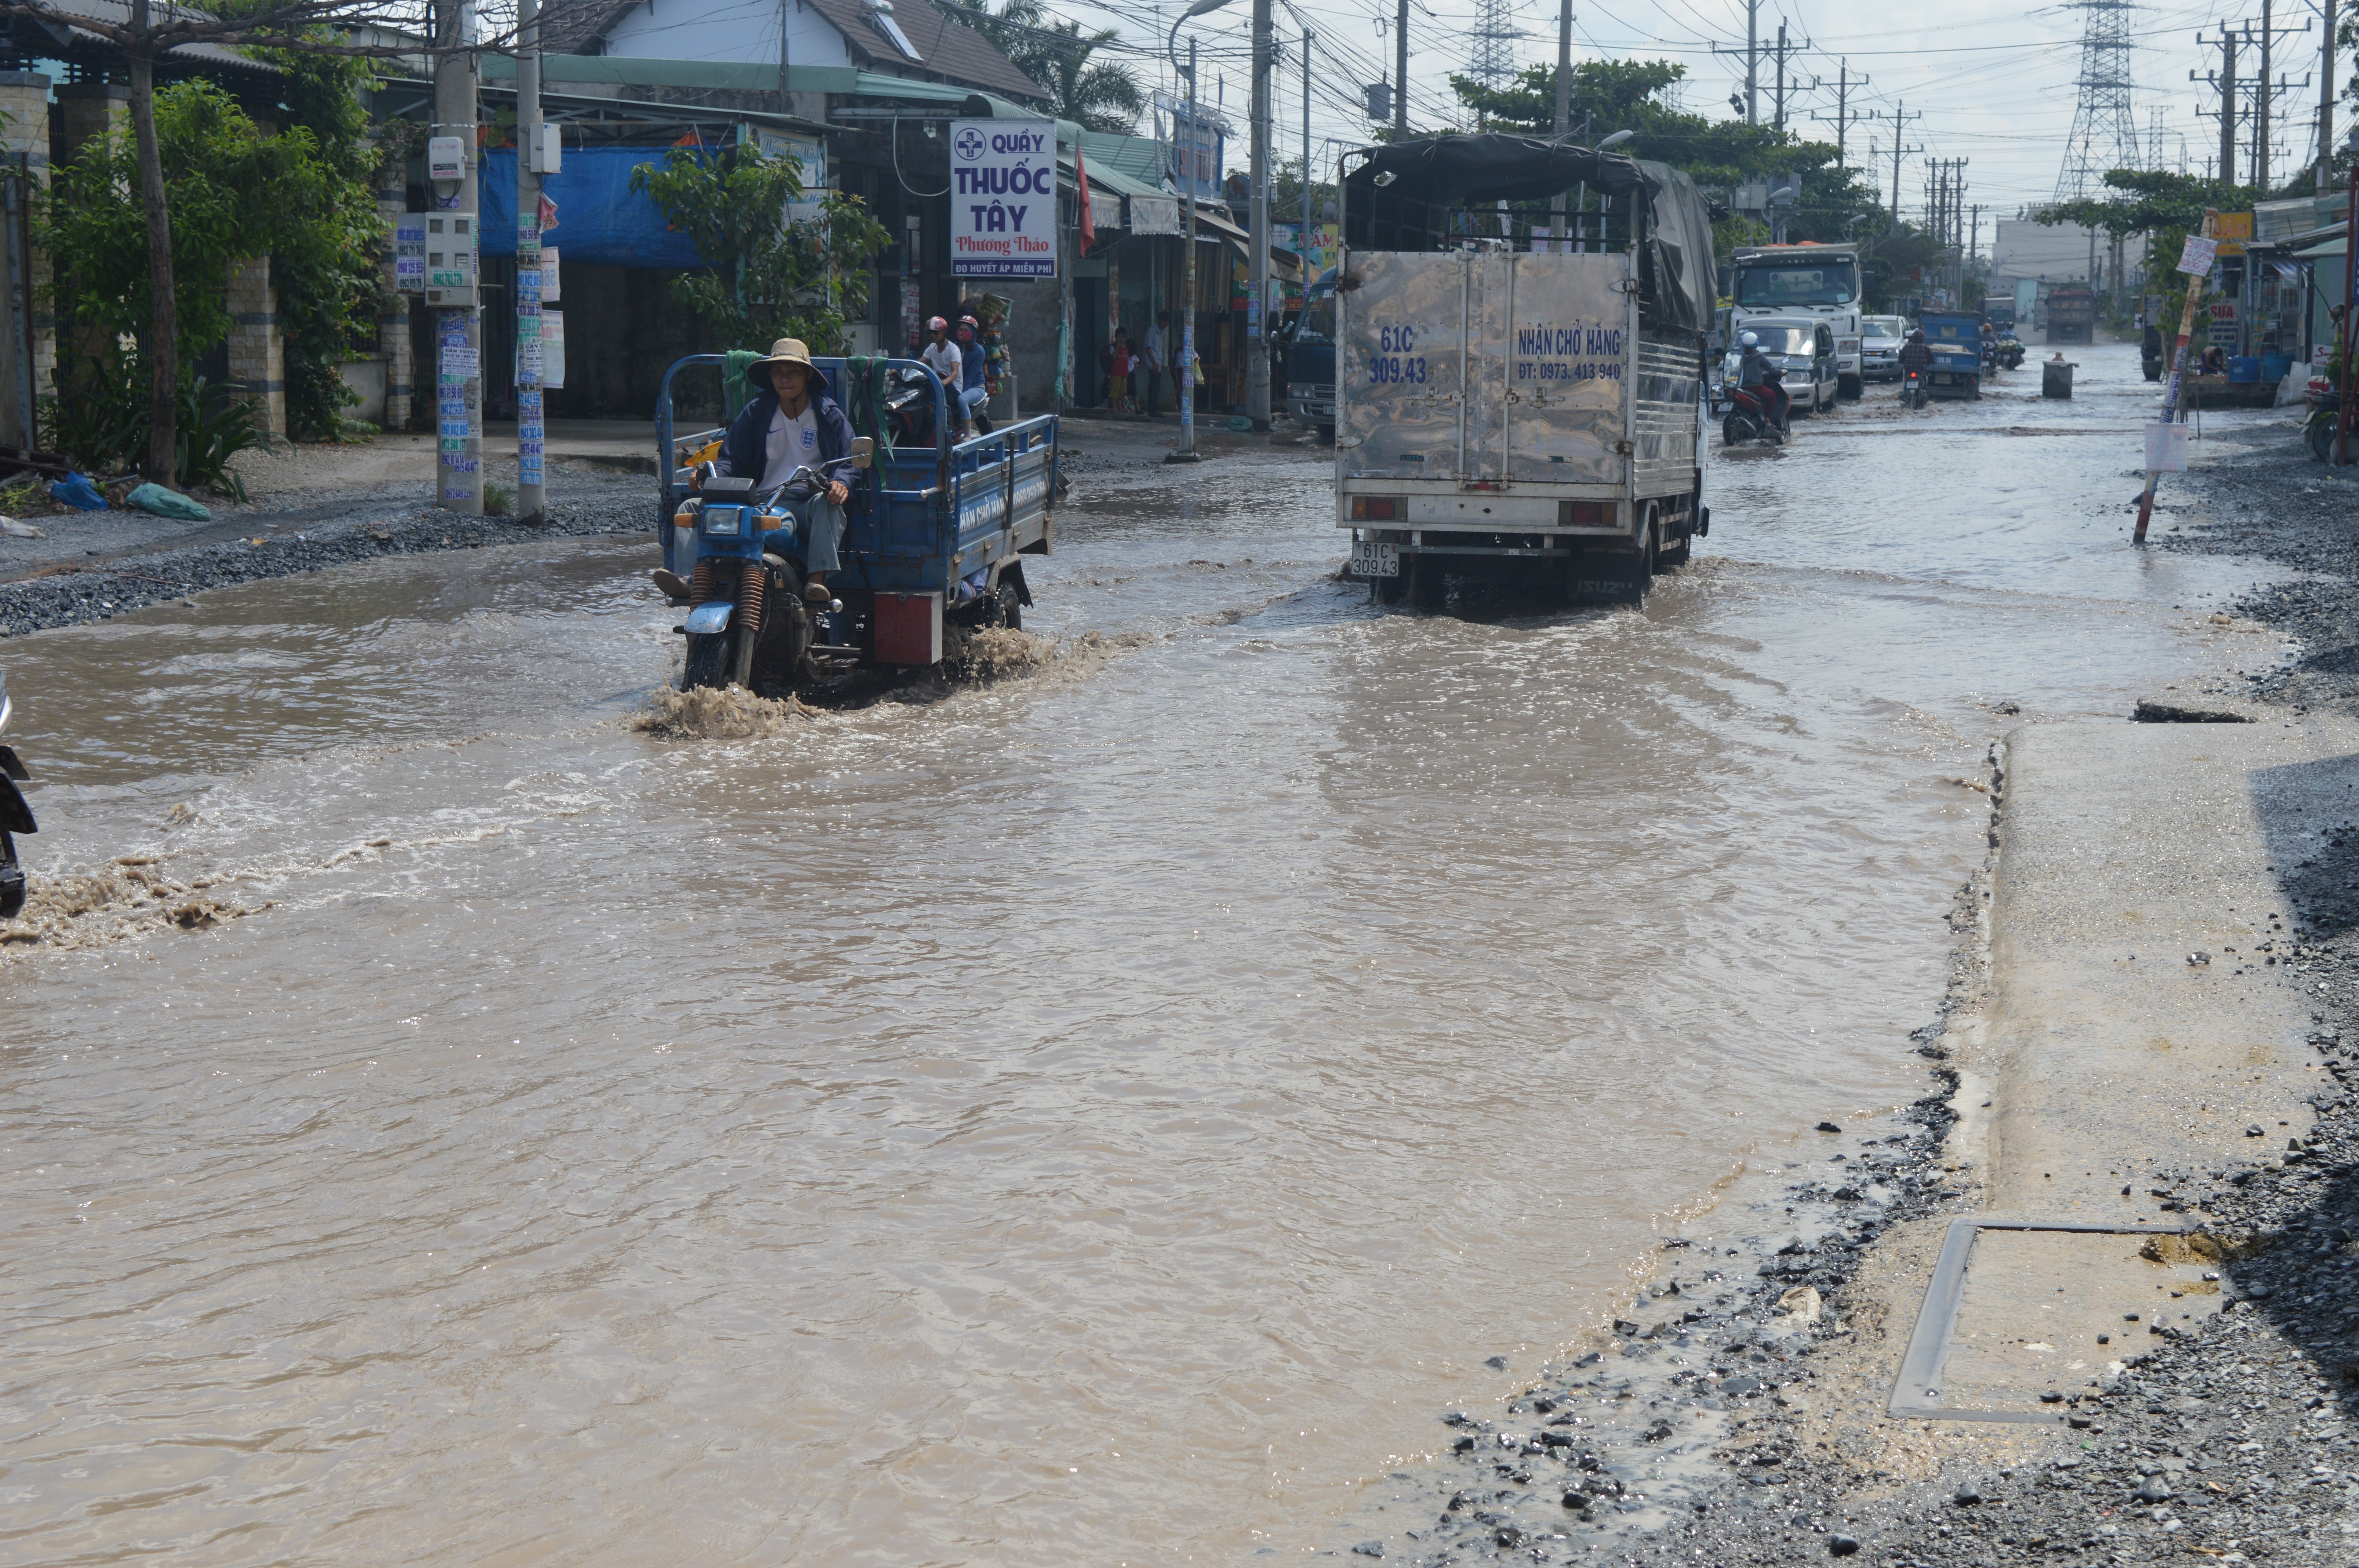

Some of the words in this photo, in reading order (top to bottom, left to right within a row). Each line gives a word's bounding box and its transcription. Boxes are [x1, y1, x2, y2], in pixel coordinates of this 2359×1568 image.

[992, 129, 1045, 154] QUẦY
[954, 158, 1050, 194] THUỐC
[970, 199, 1028, 232] TÂY
[955, 236, 1010, 256] Phương
[1014, 236, 1049, 252] Thảo
[956, 265, 968, 273] ĐO
[970, 261, 997, 273] HUYẾT
[999, 263, 1010, 273] ÁP
[1013, 261, 1035, 273] MIỄN
[1037, 263, 1052, 273] PHÍ
[1381, 326, 1412, 352] 61C
[1519, 323, 1552, 360] NHẬN
[1556, 319, 1582, 356] CHỞ
[1587, 323, 1620, 356] HÀNG
[1369, 357, 1426, 383] 309.43
[1519, 363, 1536, 379] ĐT:
[1540, 363, 1571, 379] 0973.
[1575, 363, 1595, 379] 413
[1599, 363, 1620, 380] 940
[977, 496, 990, 526] CHỞ
[991, 493, 1007, 519] HÀN
[1364, 543, 1389, 559] 61C
[1353, 559, 1397, 575] 309.43
